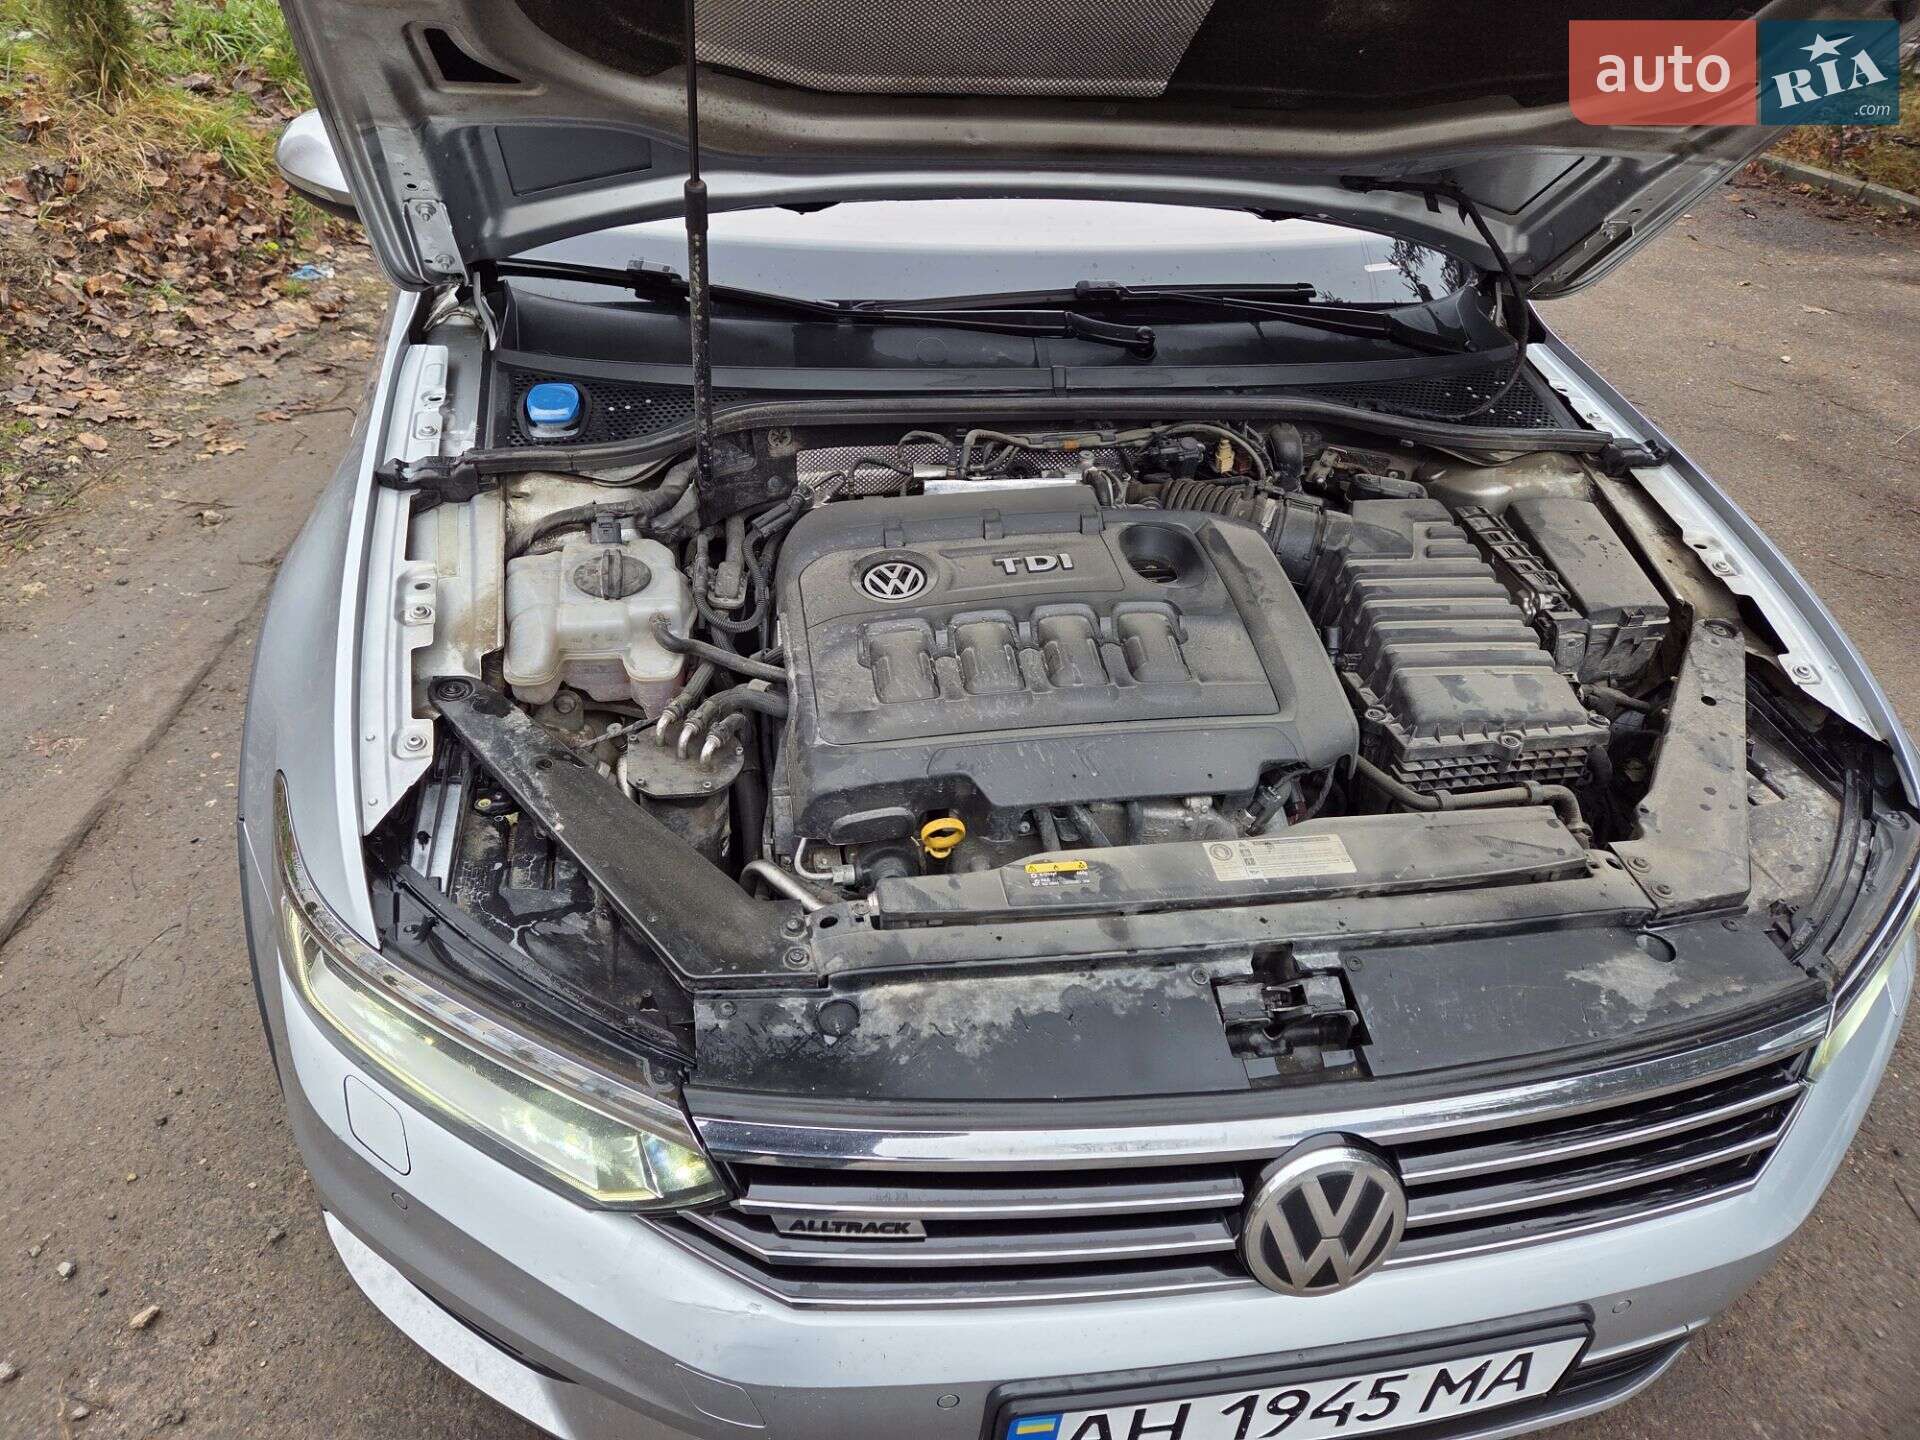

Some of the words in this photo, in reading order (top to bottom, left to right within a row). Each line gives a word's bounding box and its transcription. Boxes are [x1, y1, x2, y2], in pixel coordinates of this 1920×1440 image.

[993, 553, 1074, 575] TDI
[788, 1219, 911, 1234] ALLTRACK
[1069, 1402, 1192, 1440] AH
[1220, 1373, 1410, 1440] 1945
[1418, 1351, 1534, 1413] MA
